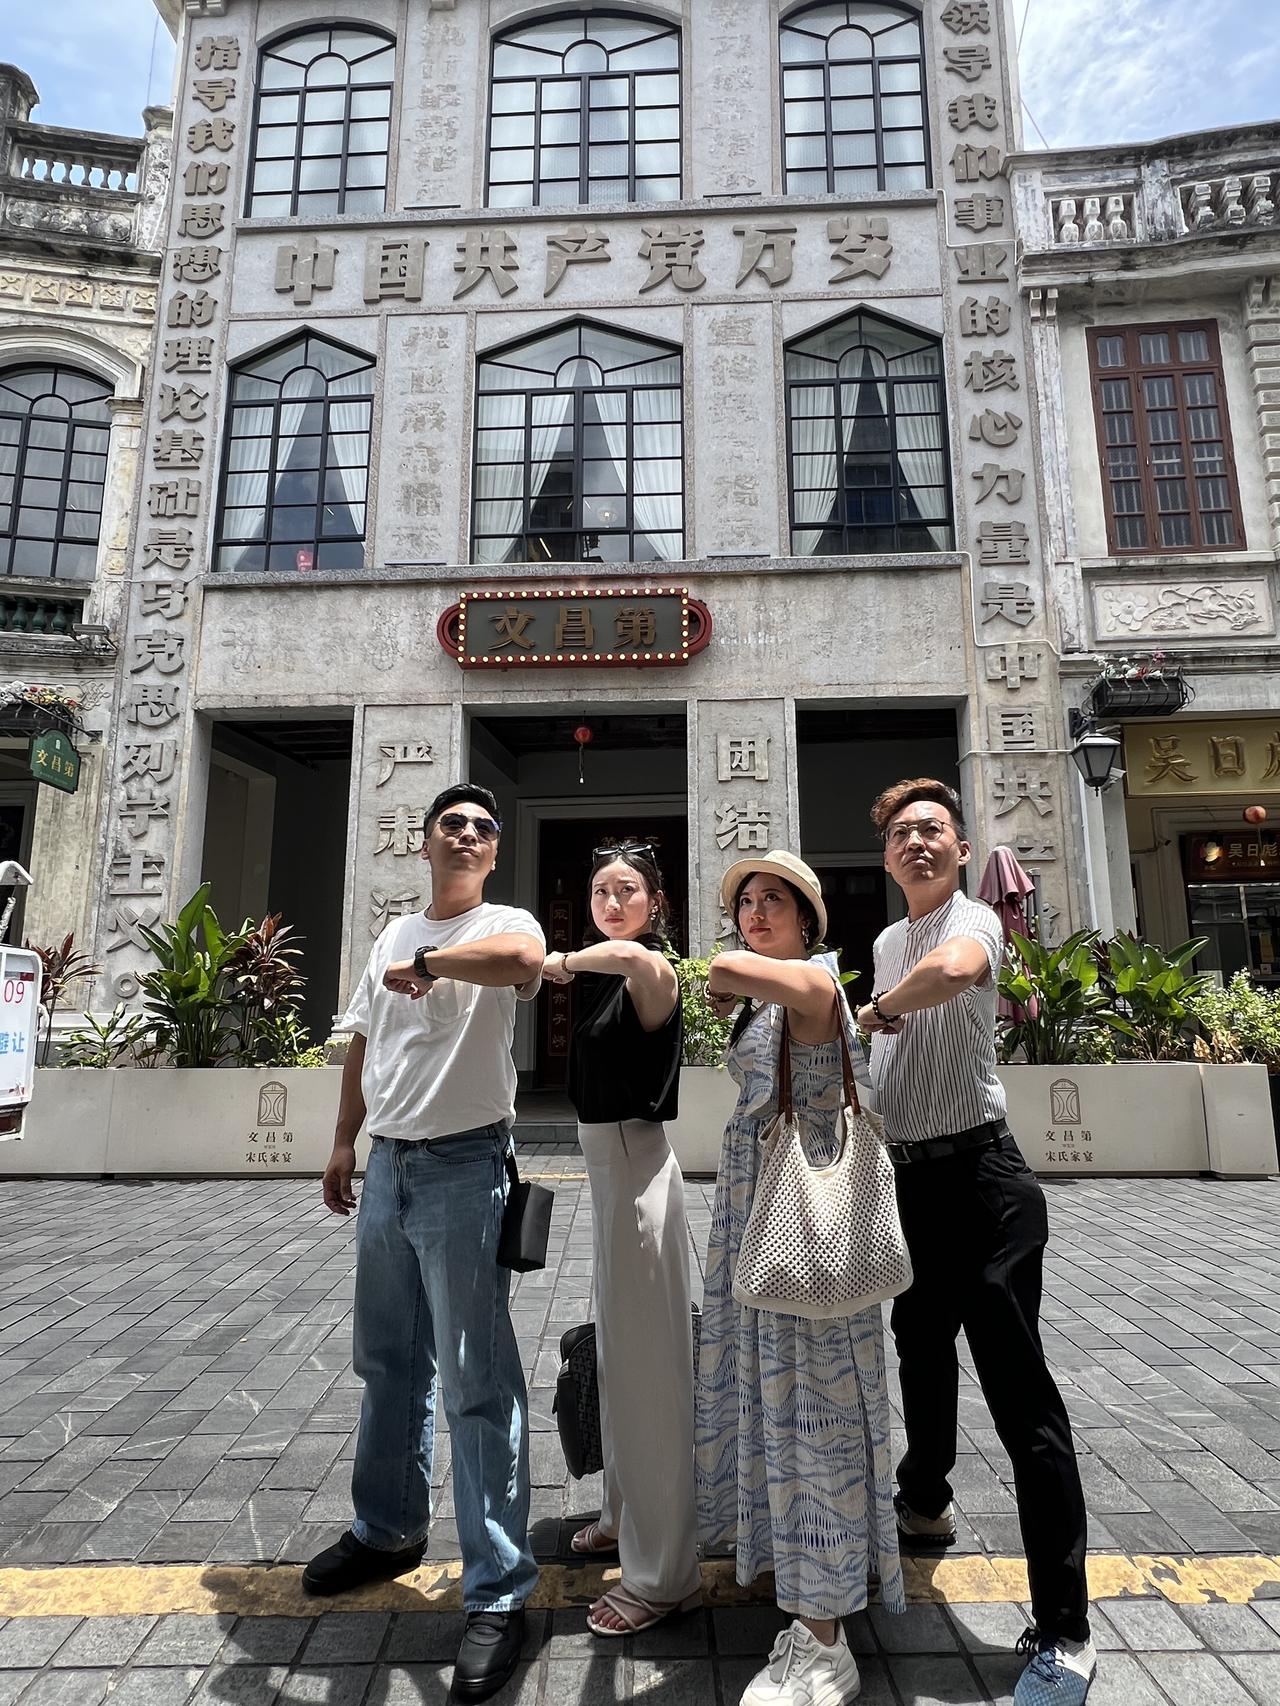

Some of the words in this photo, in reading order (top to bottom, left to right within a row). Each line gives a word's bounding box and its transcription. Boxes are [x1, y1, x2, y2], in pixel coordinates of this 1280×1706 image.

[274, 214, 893, 305] 中国共产党万岁
[487, 606, 657, 650] 文昌第
[35, 749, 74, 778] 文昌第
[715, 732, 771, 939] 团结
[4, 979, 25, 1004] 09
[248, 1132, 293, 1143] 文昌第
[1045, 1130, 1092, 1142] 文昌第
